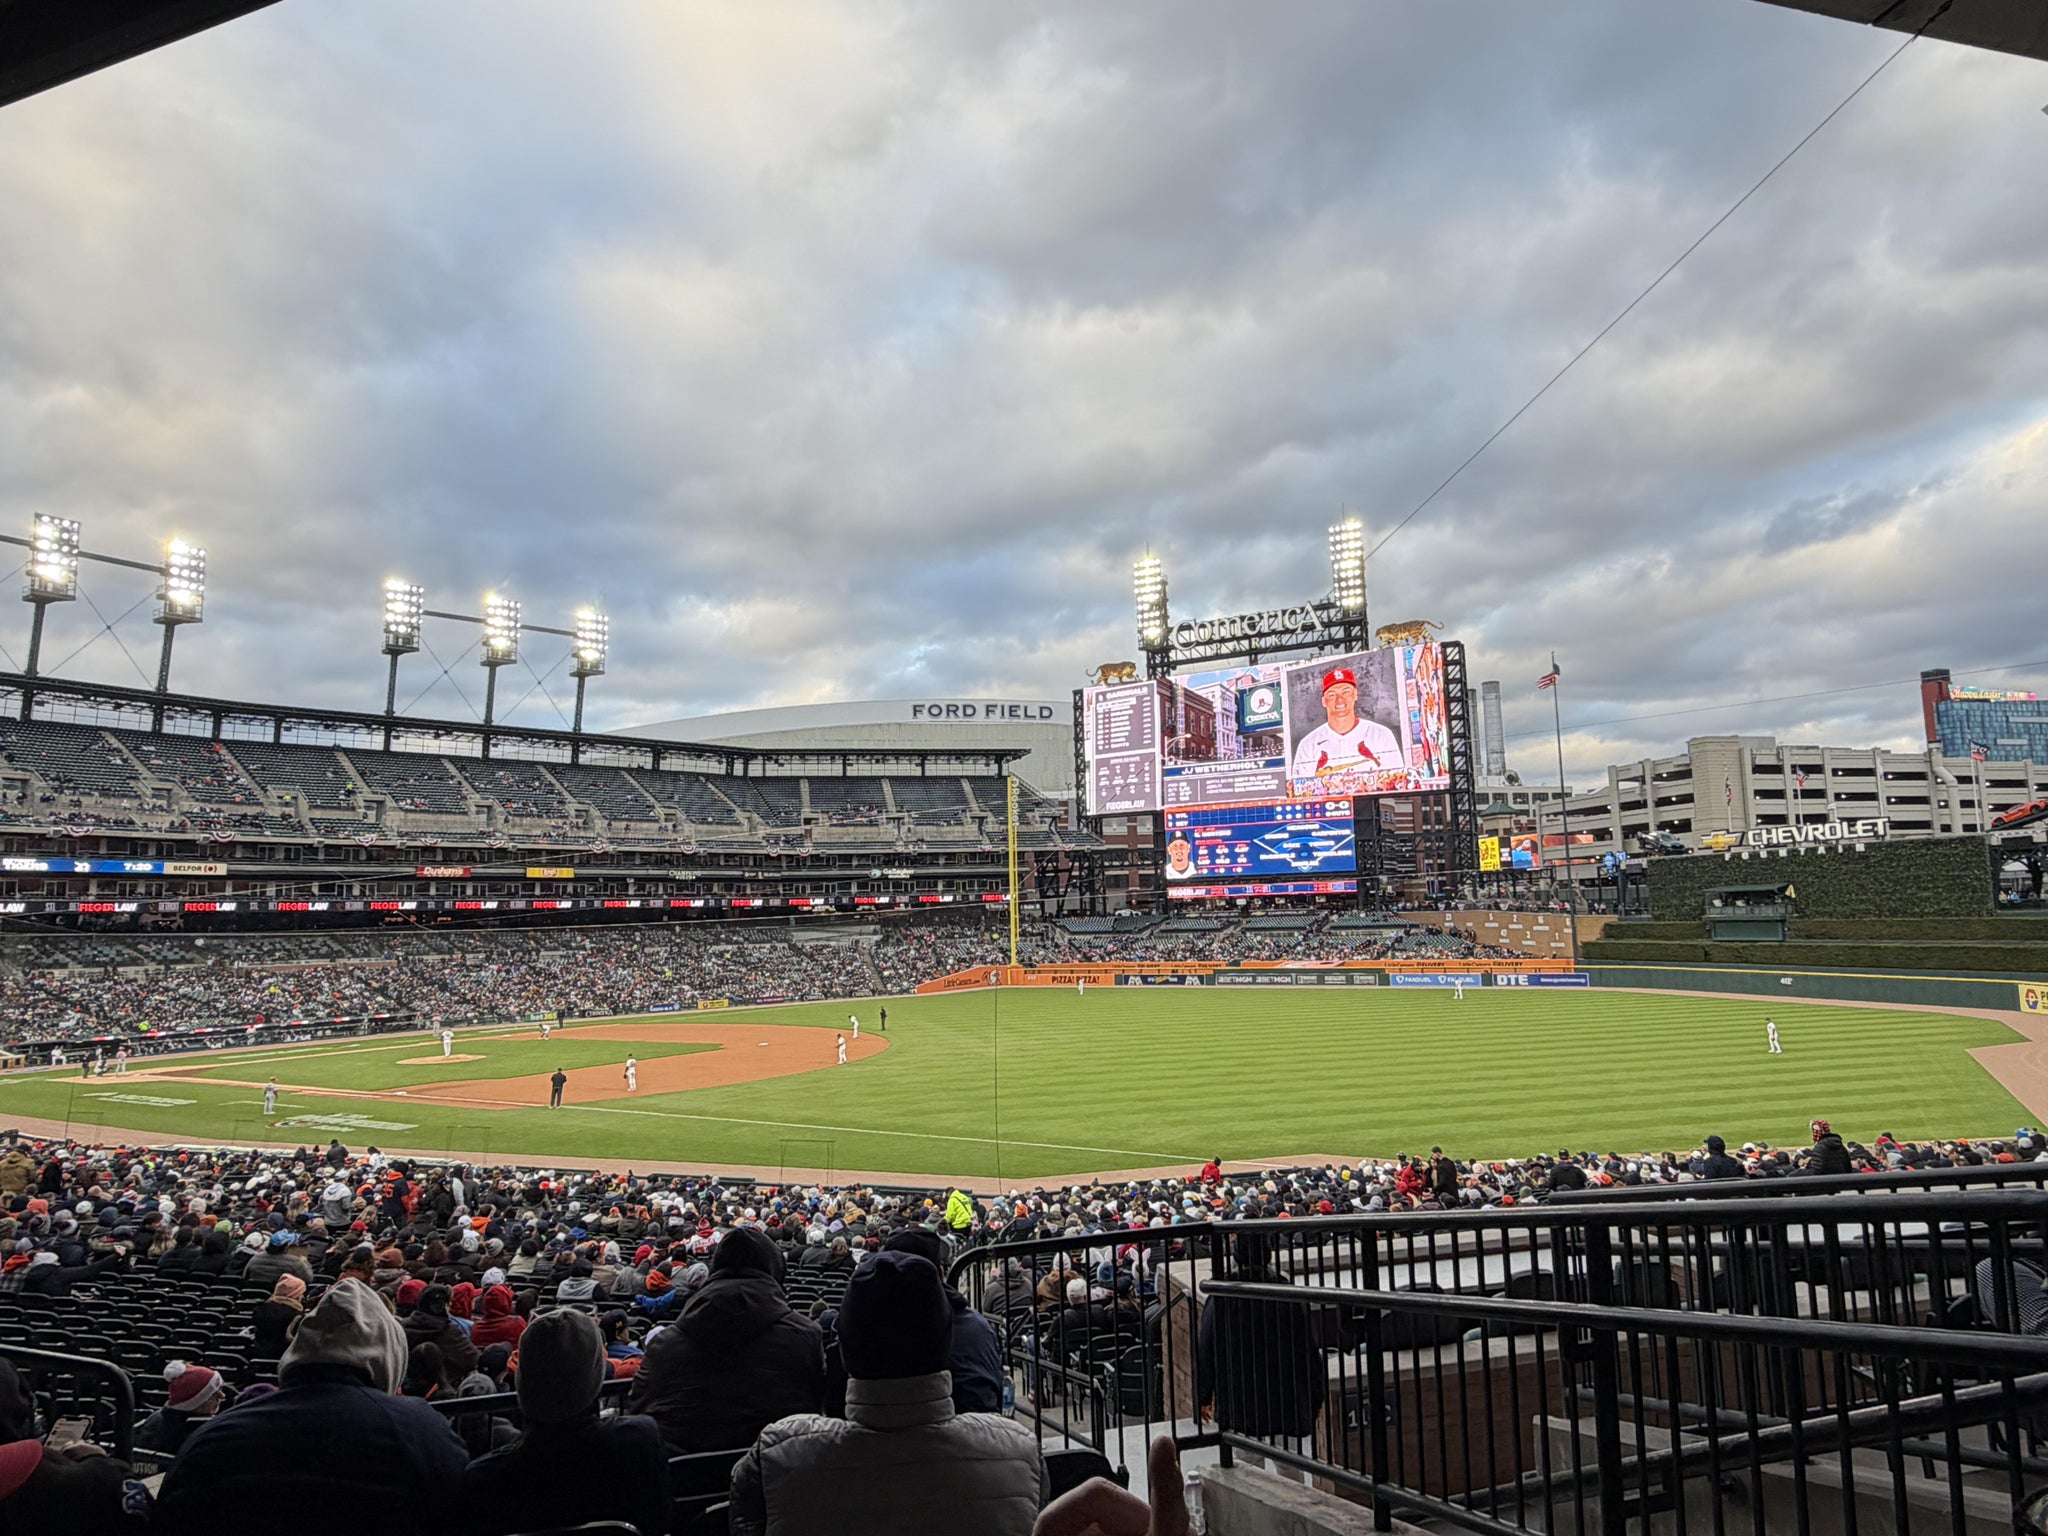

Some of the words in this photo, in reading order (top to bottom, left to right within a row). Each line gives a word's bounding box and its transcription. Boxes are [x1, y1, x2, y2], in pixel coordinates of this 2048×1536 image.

[912, 703, 977, 719] FORD
[984, 703, 1054, 720] FIELD
[1194, 760, 1266, 774] WETHERHOLT
[1747, 817, 1889, 846] CHEVROLET
[0, 902, 25, 912] LAW
[79, 902, 138, 912] FIEGERLAW
[184, 902, 237, 911] FIEGERLAW
[278, 902, 329, 911] FIEGERLAW
[370, 901, 417, 910] FIEGERLAW
[1051, 976, 1075, 984] PIZZA!
[1076, 975, 1100, 984] PZZA!
[1496, 974, 1529, 986] DTE
